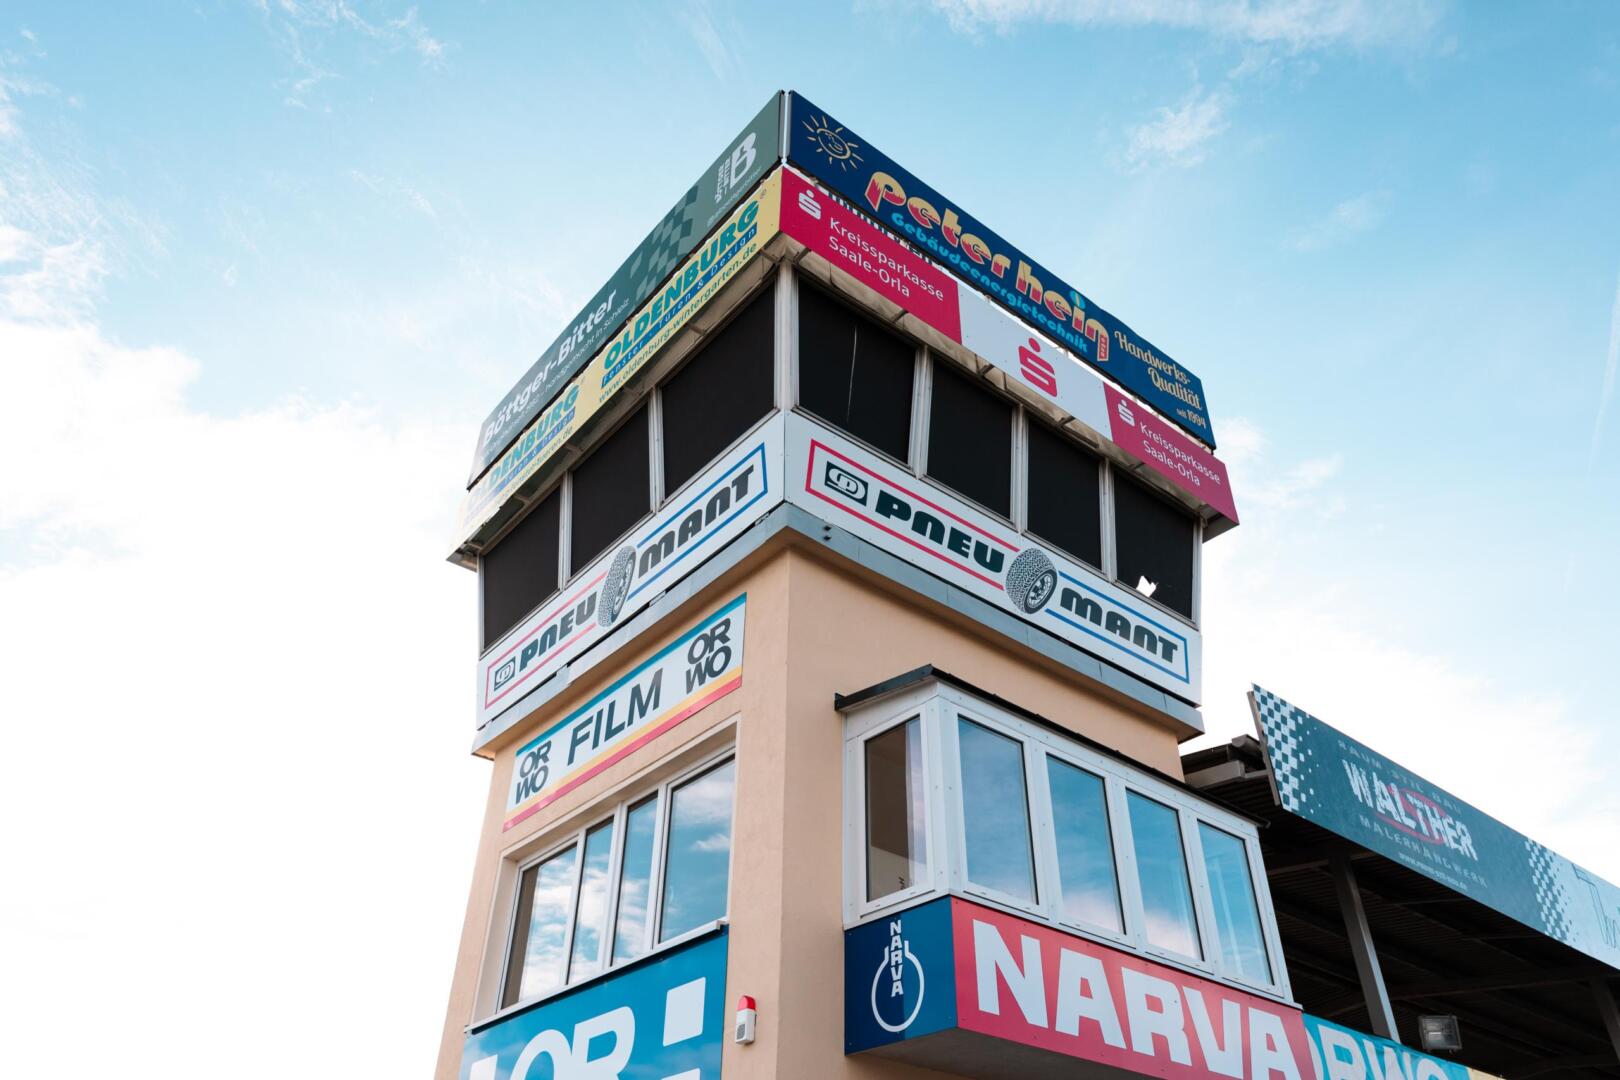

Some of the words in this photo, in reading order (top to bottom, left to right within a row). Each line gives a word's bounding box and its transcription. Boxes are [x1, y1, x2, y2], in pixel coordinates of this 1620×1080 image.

[604, 200, 759, 370] OLDENBURG
[711, 228, 755, 277] Design
[829, 236, 909, 297] Saale-Orla
[830, 218, 943, 301] Kreissparkasse
[892, 212, 1088, 354] Gebäudeenergietechnik
[484, 289, 616, 443] Böttger-Bitter
[1114, 331, 1190, 384] Handwerks-
[1148, 367, 1202, 410] Qualität
[478, 384, 579, 498] DENBURG
[1140, 422, 1221, 484] Kreissparkasse
[1143, 440, 1201, 486] Saale-Orla
[519, 592, 598, 672] PNEU
[638, 465, 754, 578] MANT
[875, 489, 1005, 573] PNEU
[1060, 587, 1179, 663] MANT
[567, 668, 664, 766] FILM
[1342, 759, 1478, 862] WALTHER
[889, 919, 904, 998] NARVA
[973, 919, 1302, 1080] NARVA
